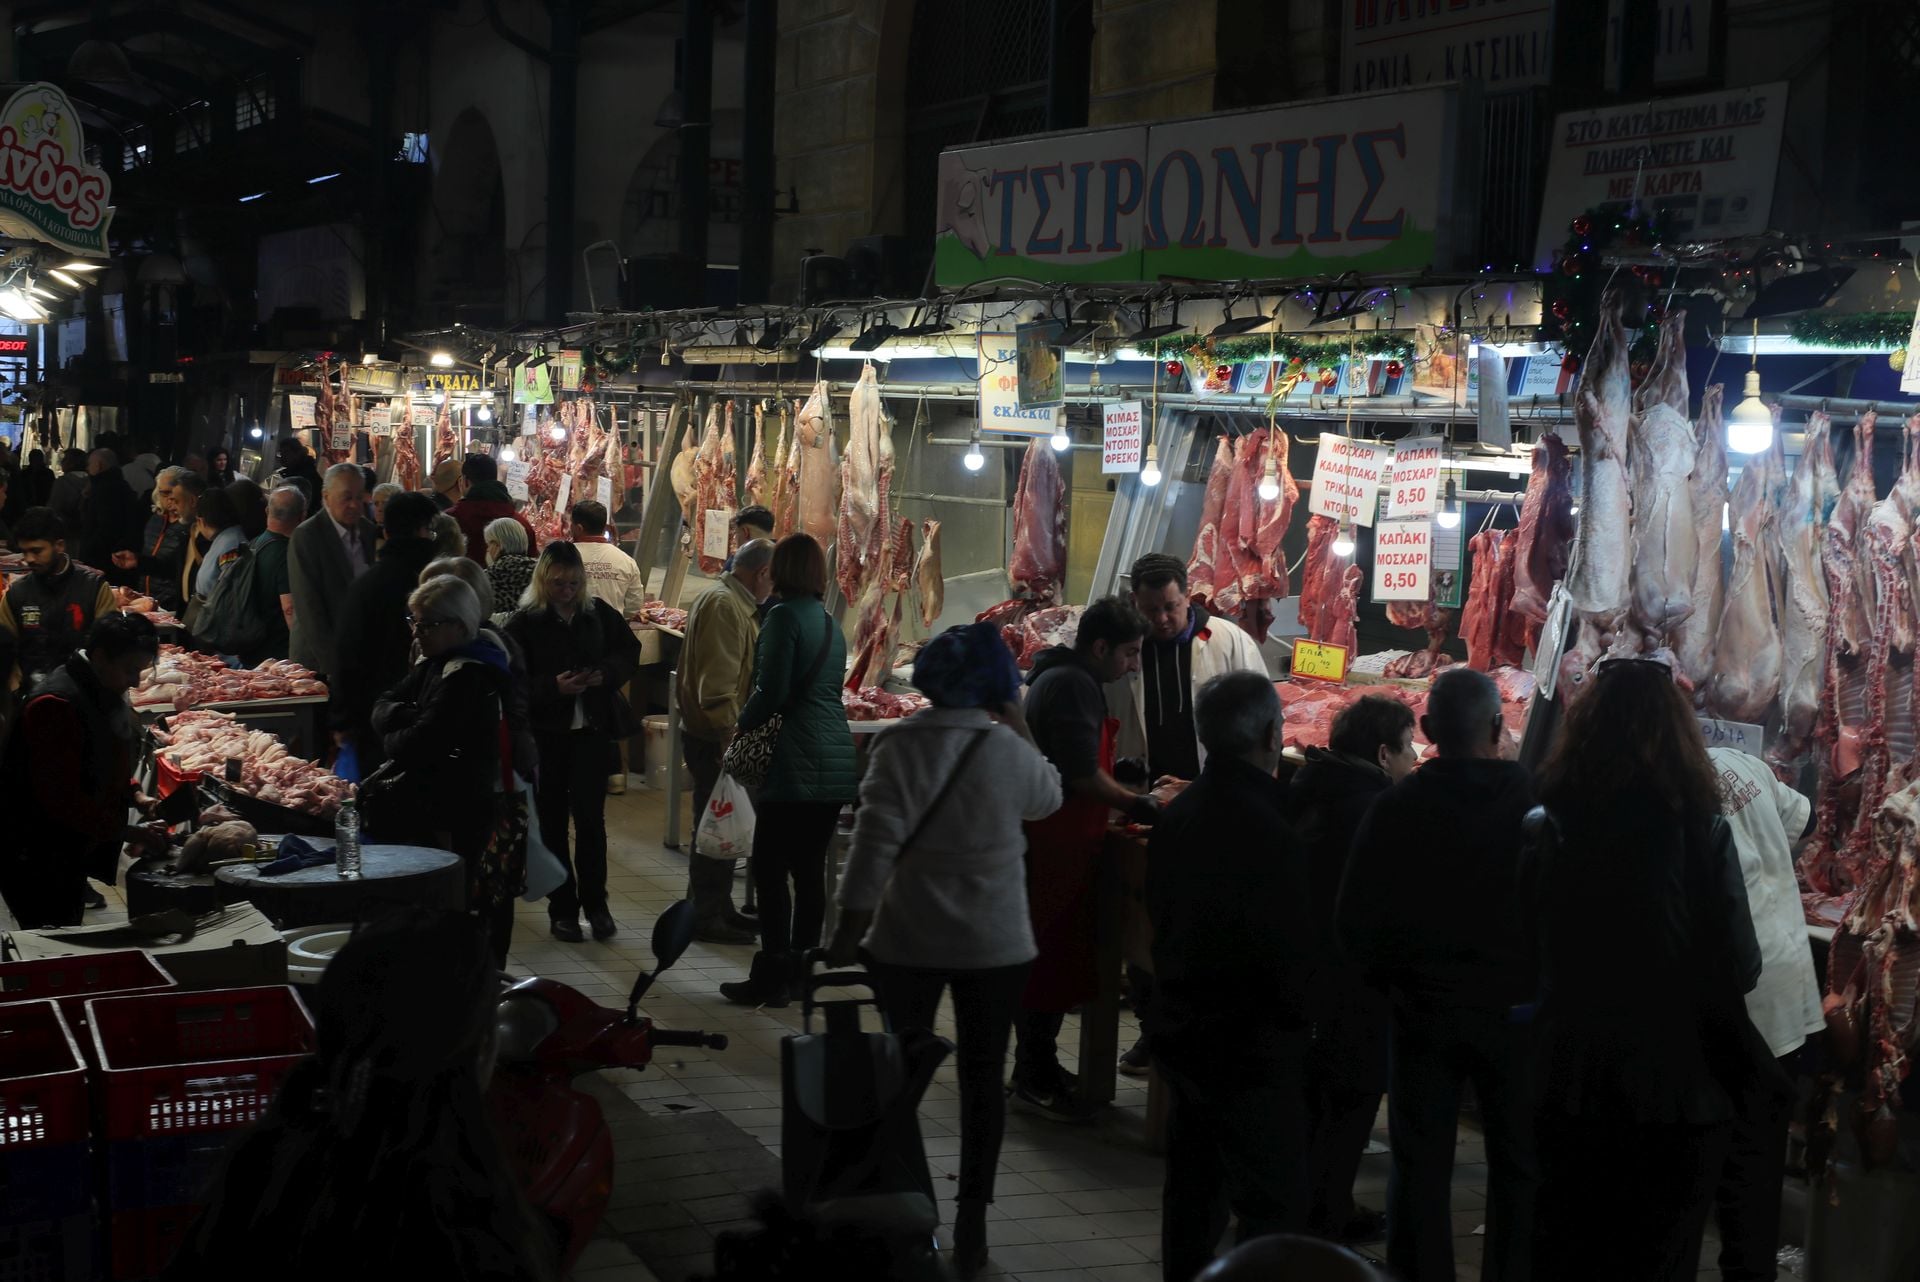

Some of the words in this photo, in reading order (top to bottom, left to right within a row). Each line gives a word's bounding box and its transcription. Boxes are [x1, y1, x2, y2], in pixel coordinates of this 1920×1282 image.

[1565, 120, 1603, 143] ΣΤΟ
[1606, 103, 1718, 138] ΚΑΤΑΣΤΗΜΑ
[1723, 97, 1766, 121] ΜΑΣ
[1699, 135, 1735, 161] ΚΑΙ
[990, 122, 1407, 257] ΤΣΙΡΩΝΗΣ
[1607, 177, 1633, 200] ΜΕ
[1643, 169, 1703, 197] ΚΑΡΤΑ
[1106, 411, 1139, 424] ΚΙΜΑΣ
[1106, 425, 1140, 437] ΜΟΣΧΑΡΙ
[1105, 438, 1139, 451] ΝΤΟΠΙΟ
[1332, 443, 1375, 461] ΜΟΣΧΑΡΙ
[1104, 452, 1139, 464] ΦΡΕΣΚΟ
[1396, 446, 1438, 464] ΚΑΠΑΚΙ
[1319, 459, 1378, 482] ΚΑΛΑΜΠΑΚΑ
[1392, 467, 1437, 483] ΜΟΣΧΑΡΙ
[1325, 480, 1364, 499] ΤΡΙΚΑΛΑ
[1397, 487, 1426, 507] 8,50
[1323, 499, 1359, 517] ΝΤΟΠΙΟ
[1379, 532, 1426, 545] ΚΑΠΑΚΙ
[1376, 553, 1428, 566] ΜΟΣΧΑΡΙ
[1383, 572, 1417, 591] 8,50
